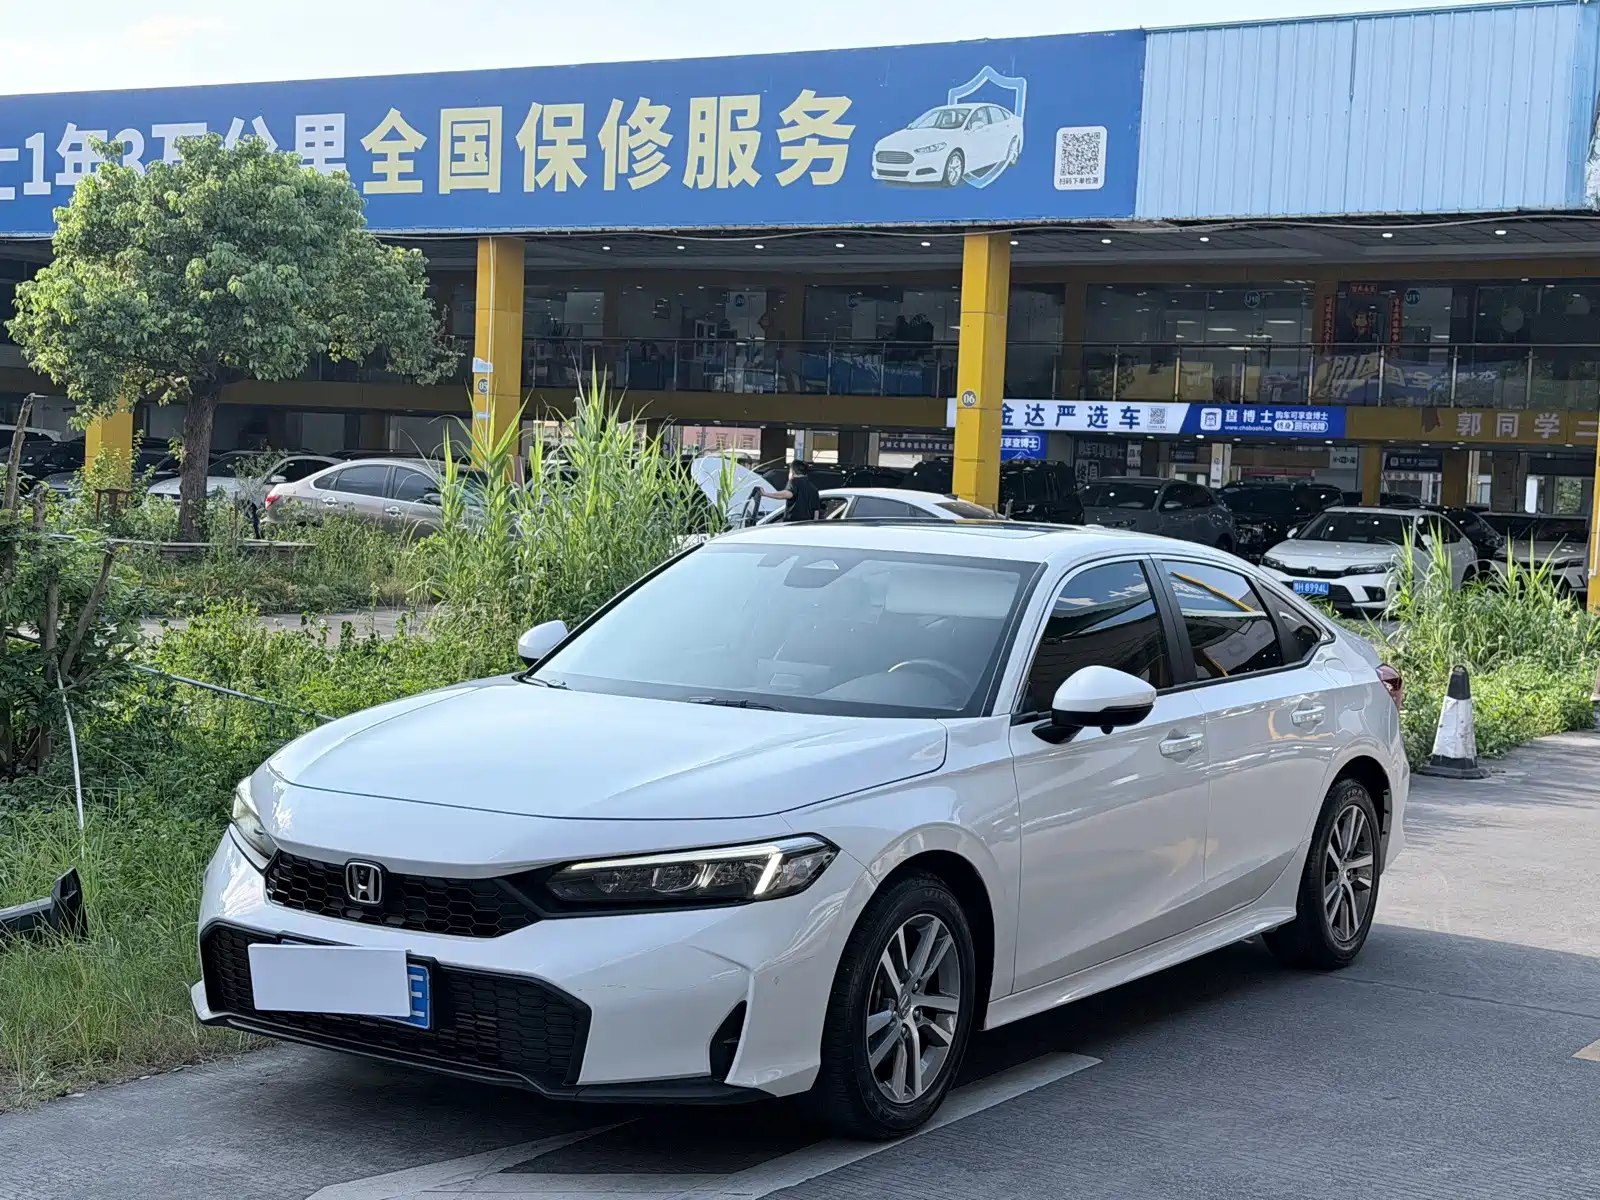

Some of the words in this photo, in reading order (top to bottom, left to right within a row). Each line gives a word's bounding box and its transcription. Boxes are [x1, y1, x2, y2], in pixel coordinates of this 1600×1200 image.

[1059, 177, 1098, 185] 扫码下单检测
[963, 394, 976, 404] 06
[1225, 409, 1273, 424] 查博士
[1275, 410, 1328, 420] 购车可享查博士
